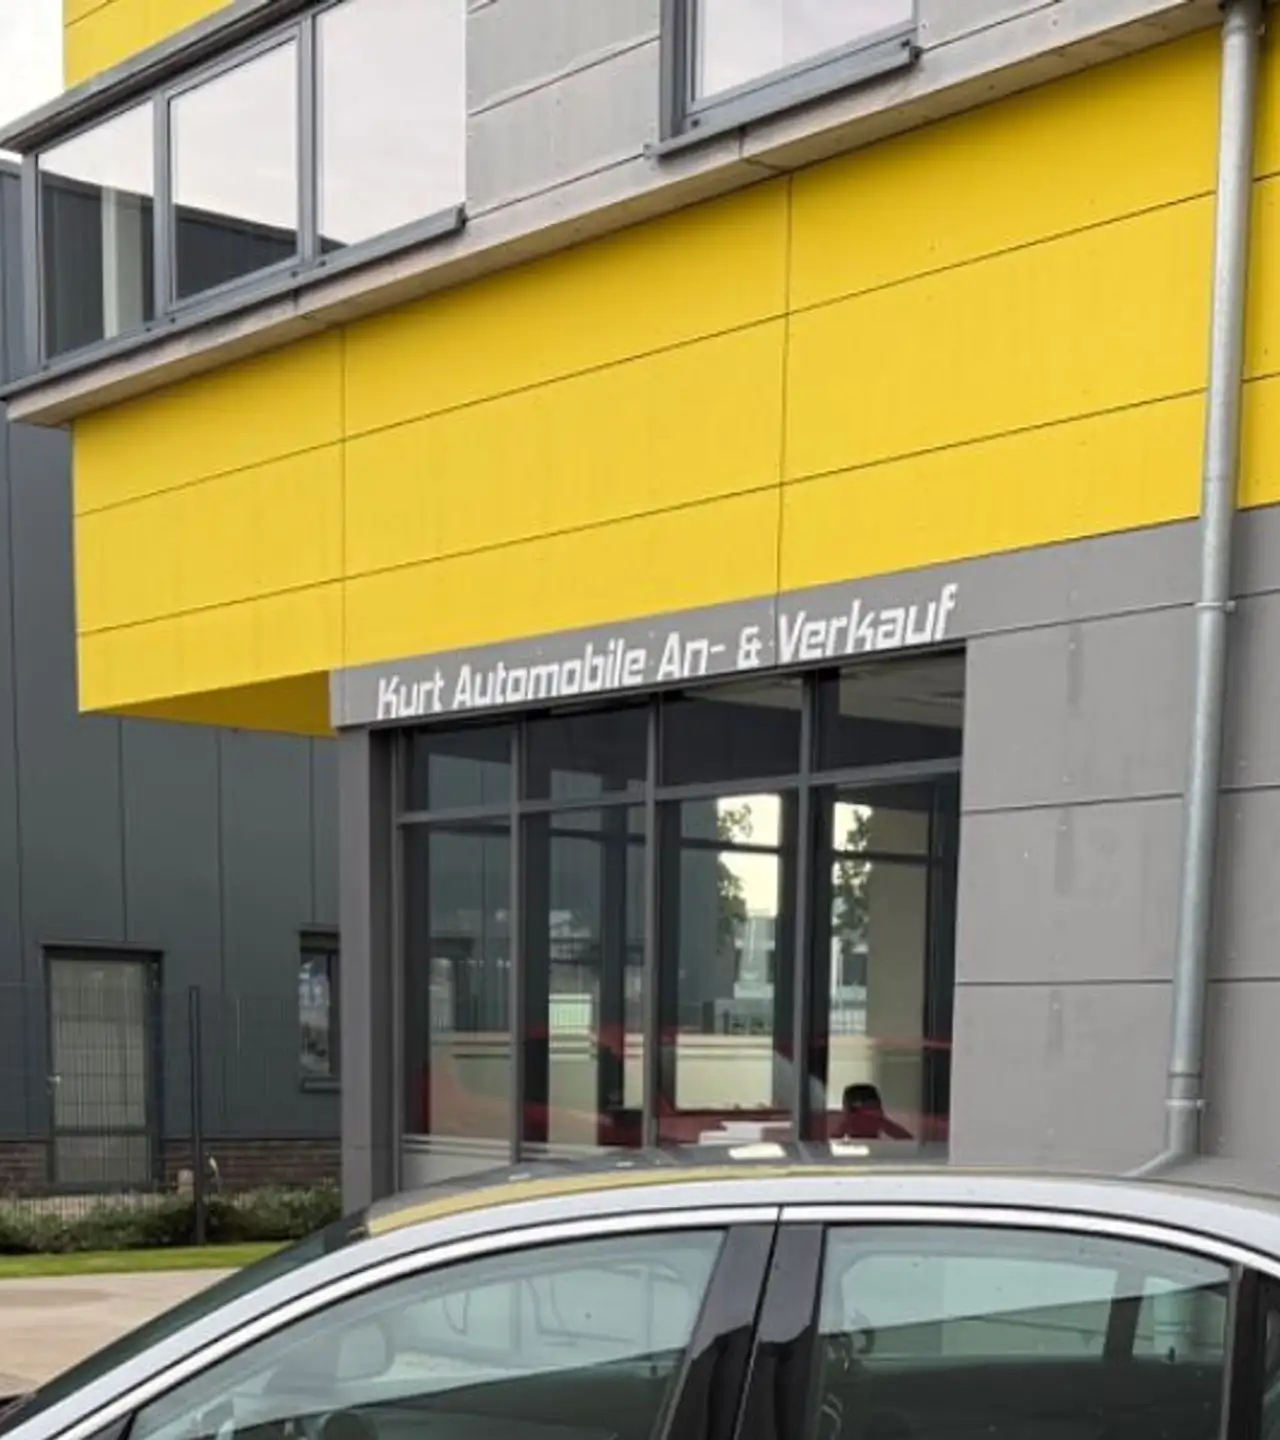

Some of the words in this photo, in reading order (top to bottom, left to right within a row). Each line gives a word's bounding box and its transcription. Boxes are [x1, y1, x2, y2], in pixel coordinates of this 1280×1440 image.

[376, 669, 444, 720] Kurt
[453, 638, 646, 710] Automobile
[657, 631, 726, 681] An-
[736, 624, 763, 668] &
[778, 583, 958, 664] Verkauf
